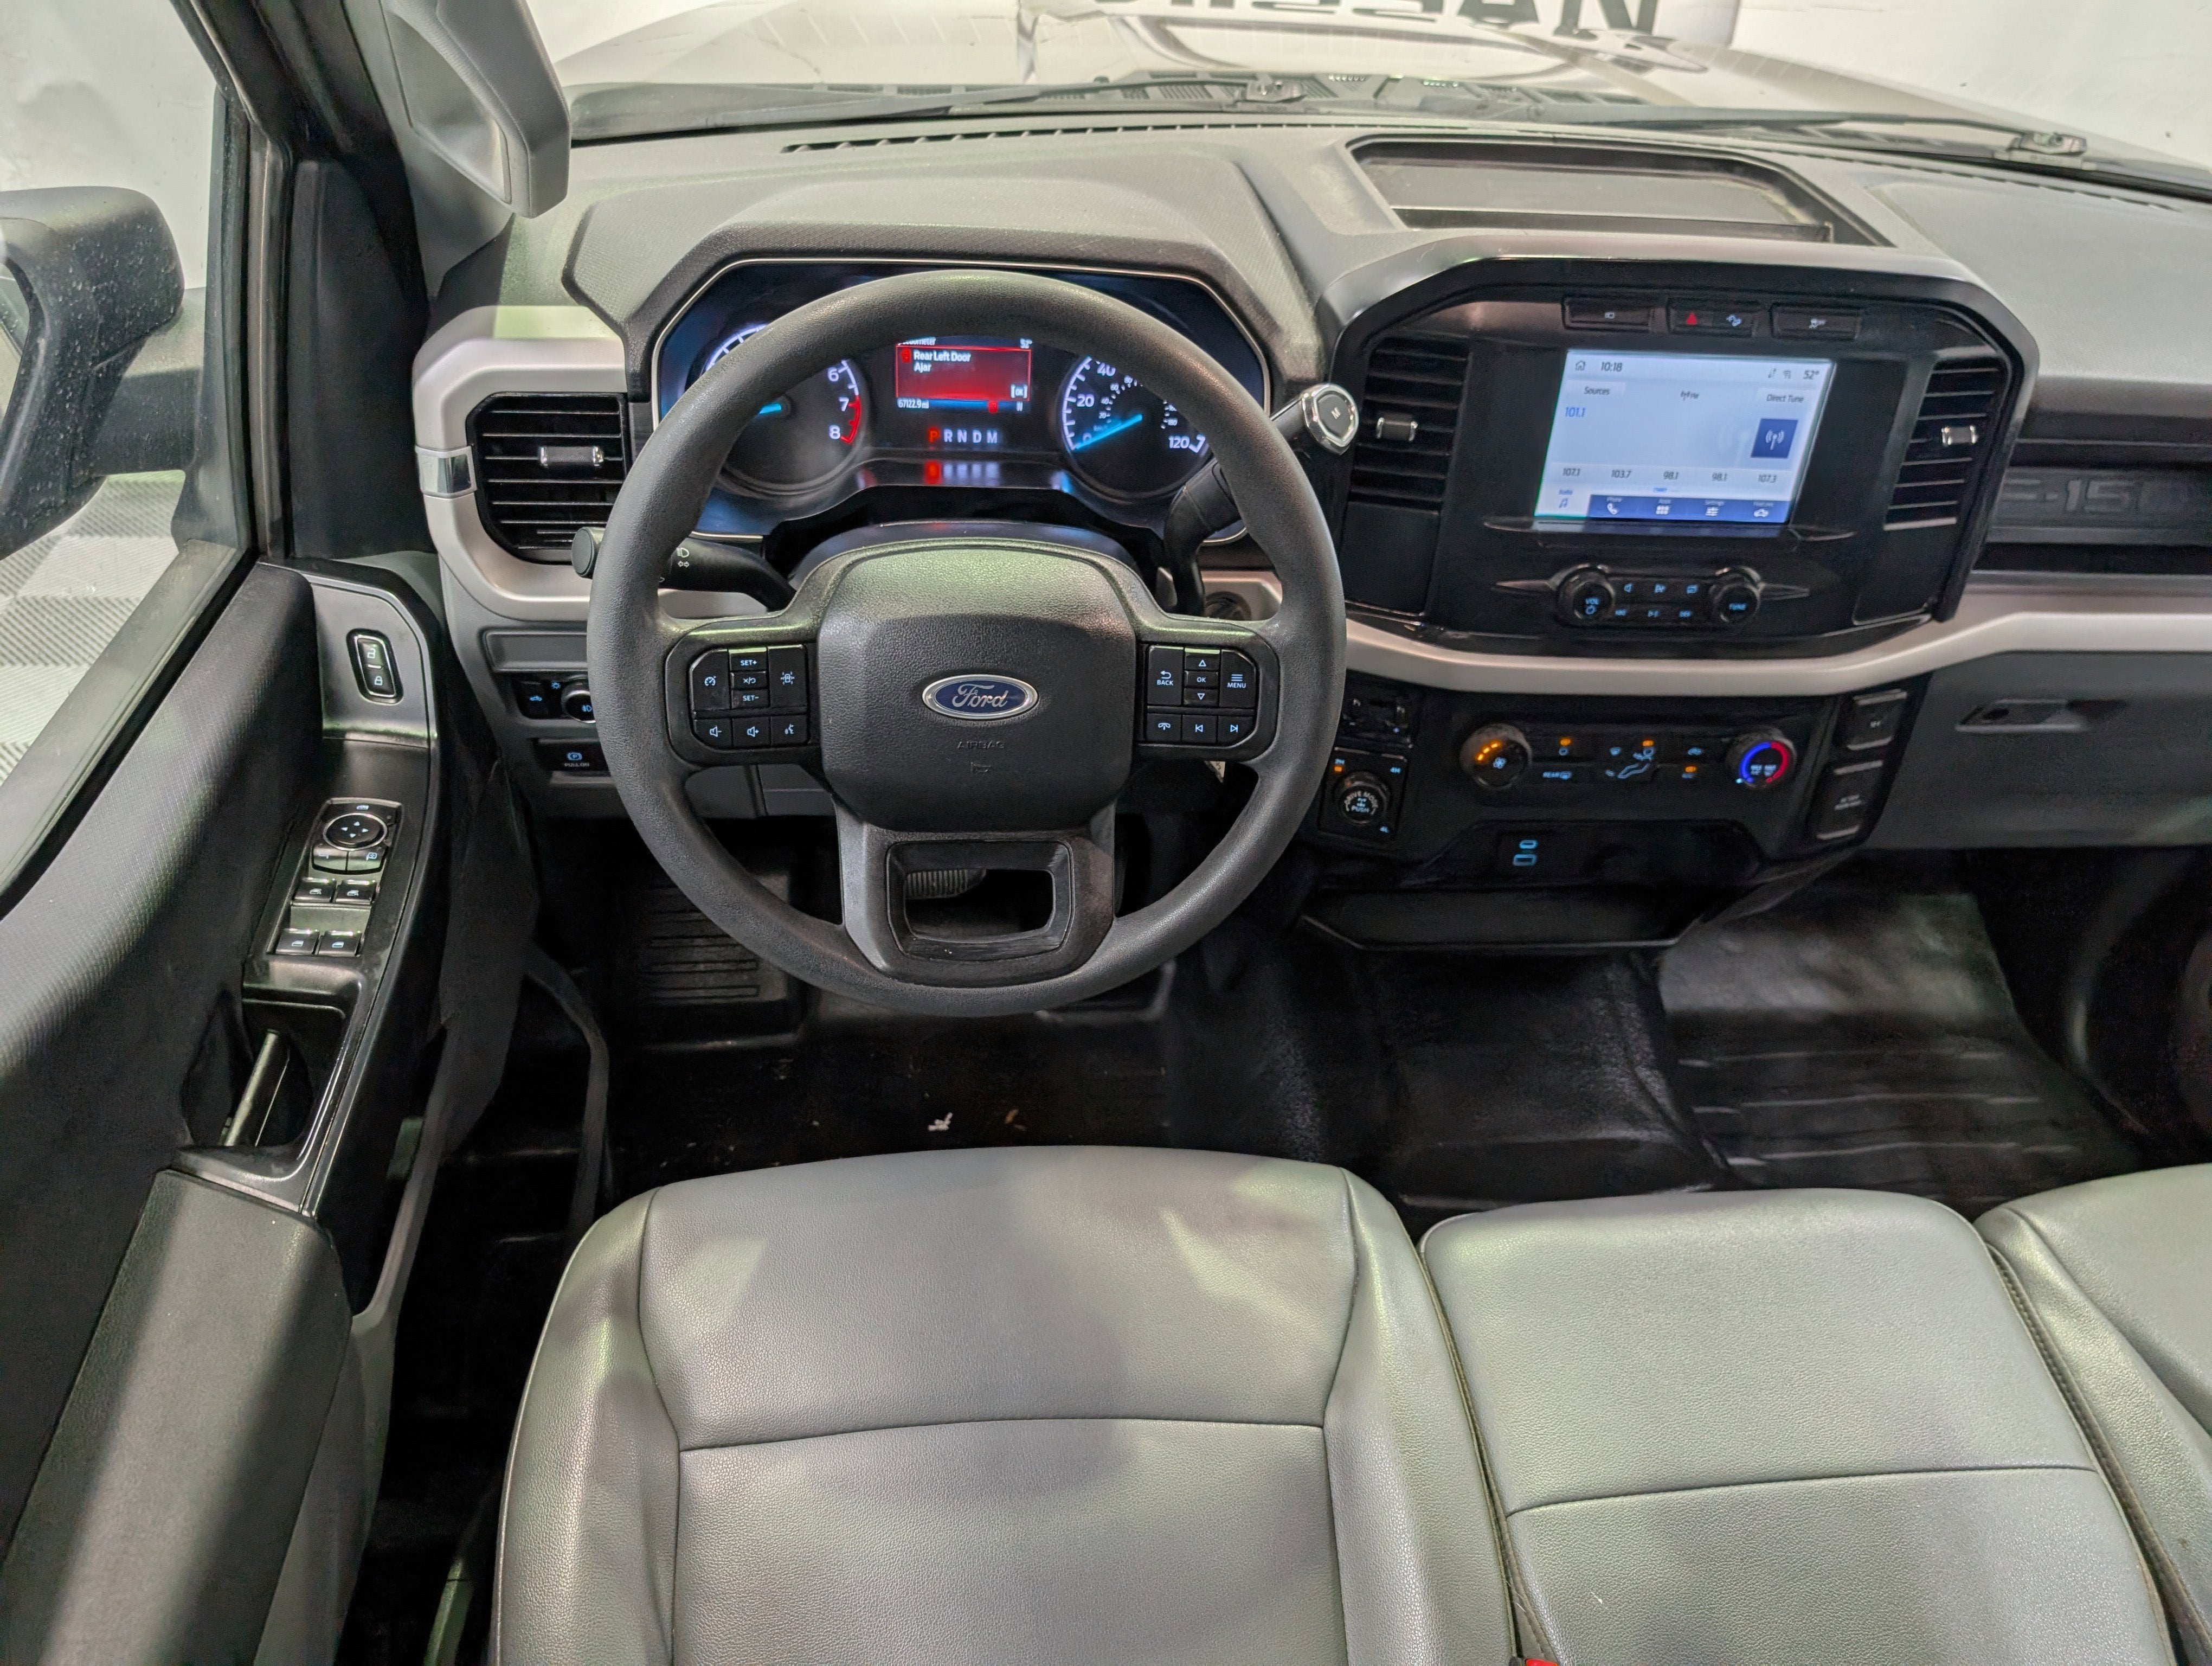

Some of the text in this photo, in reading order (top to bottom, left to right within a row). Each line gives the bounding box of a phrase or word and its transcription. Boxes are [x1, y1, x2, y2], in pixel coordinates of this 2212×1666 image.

[913, 350, 972, 362] Rear Left Door
[914, 362, 931, 373] Ajar
[1601, 362, 1623, 372] 10:18
[828, 369, 839, 381] 6
[1803, 369, 1819, 380] 52°
[1584, 387, 1610, 395] Sources
[1077, 394, 1095, 407] 20
[1766, 394, 1804, 402] Direct Tune
[839, 398, 849, 411] 7
[1565, 407, 1586, 417] 101.1
[829, 425, 840, 439] 8
[929, 429, 998, 443] P R N D M
[1169, 435, 1190, 448] 120
[1611, 470, 1631, 478] 103.7
[952, 683, 1009, 708] Ford
